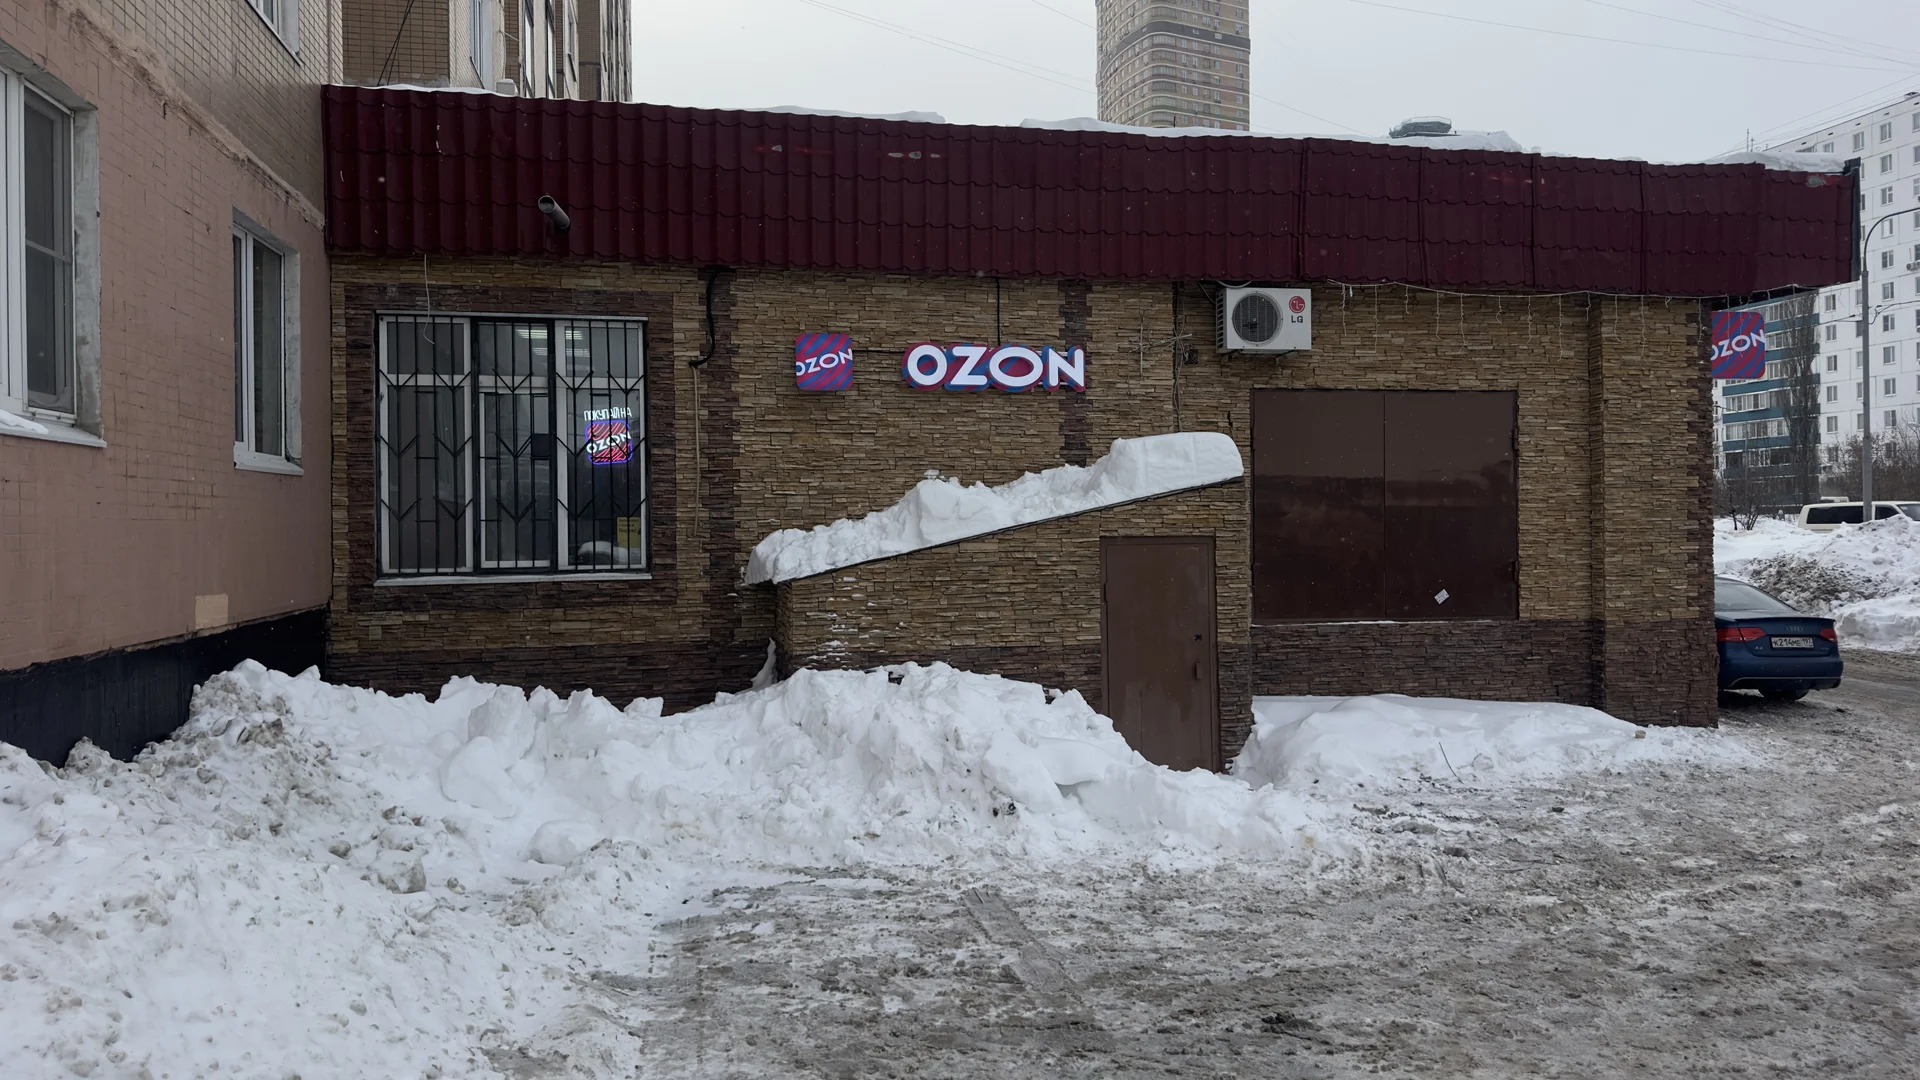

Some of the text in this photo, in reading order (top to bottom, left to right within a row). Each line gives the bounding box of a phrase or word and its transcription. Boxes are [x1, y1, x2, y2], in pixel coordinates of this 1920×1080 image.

[1291, 315, 1303, 323] LG
[796, 348, 853, 376] OZON
[905, 343, 1086, 389] OZON
[586, 431, 632, 453] OZON
